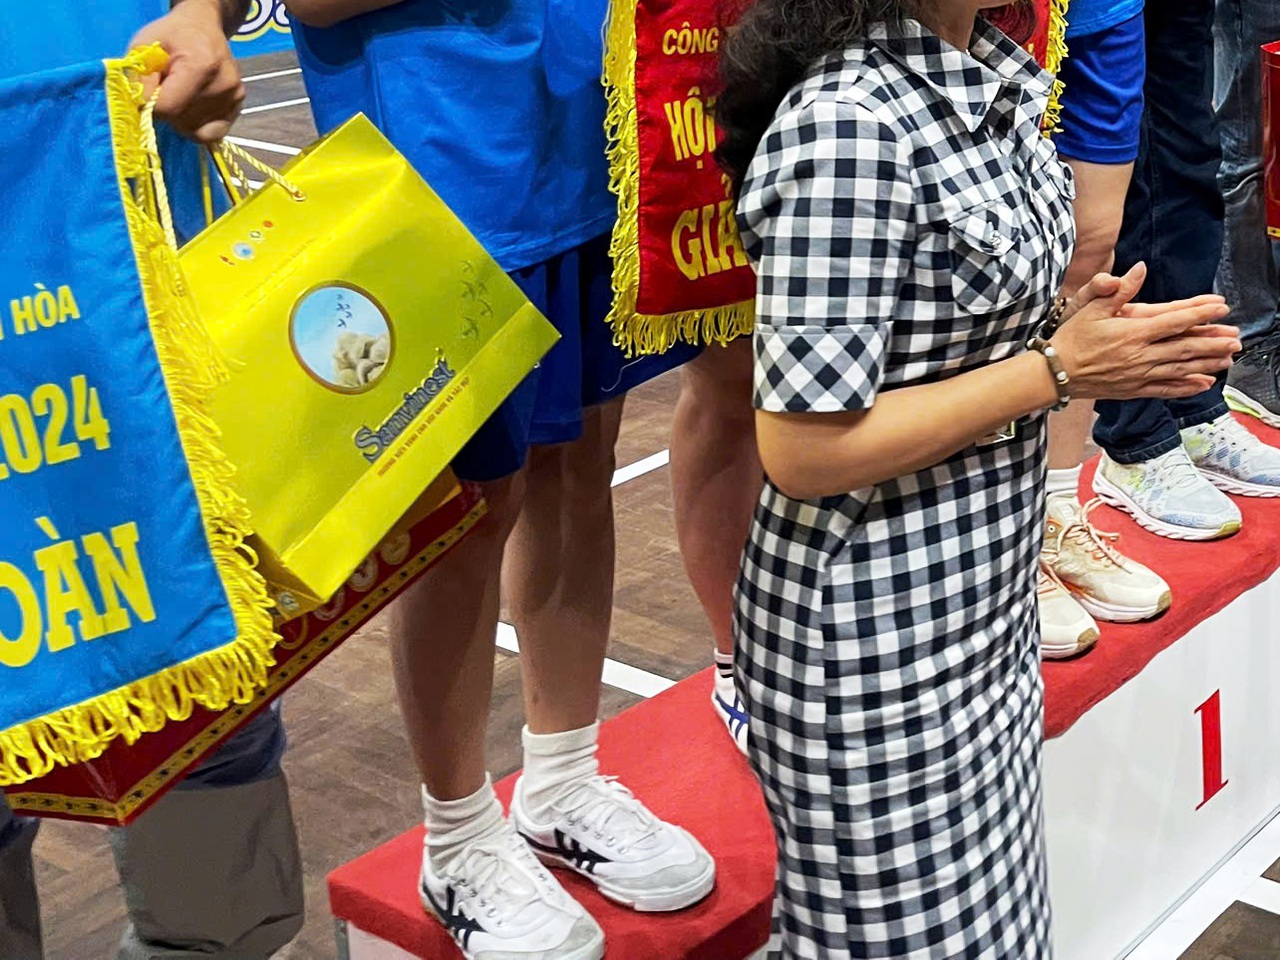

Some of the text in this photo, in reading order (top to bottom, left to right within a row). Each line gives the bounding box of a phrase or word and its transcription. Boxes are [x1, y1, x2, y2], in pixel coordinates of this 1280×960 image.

[662, 21, 719, 56] CÔNG
[10, 283, 81, 335] HÒA
[0, 374, 112, 481] 024
[1194, 688, 1229, 811] 1
